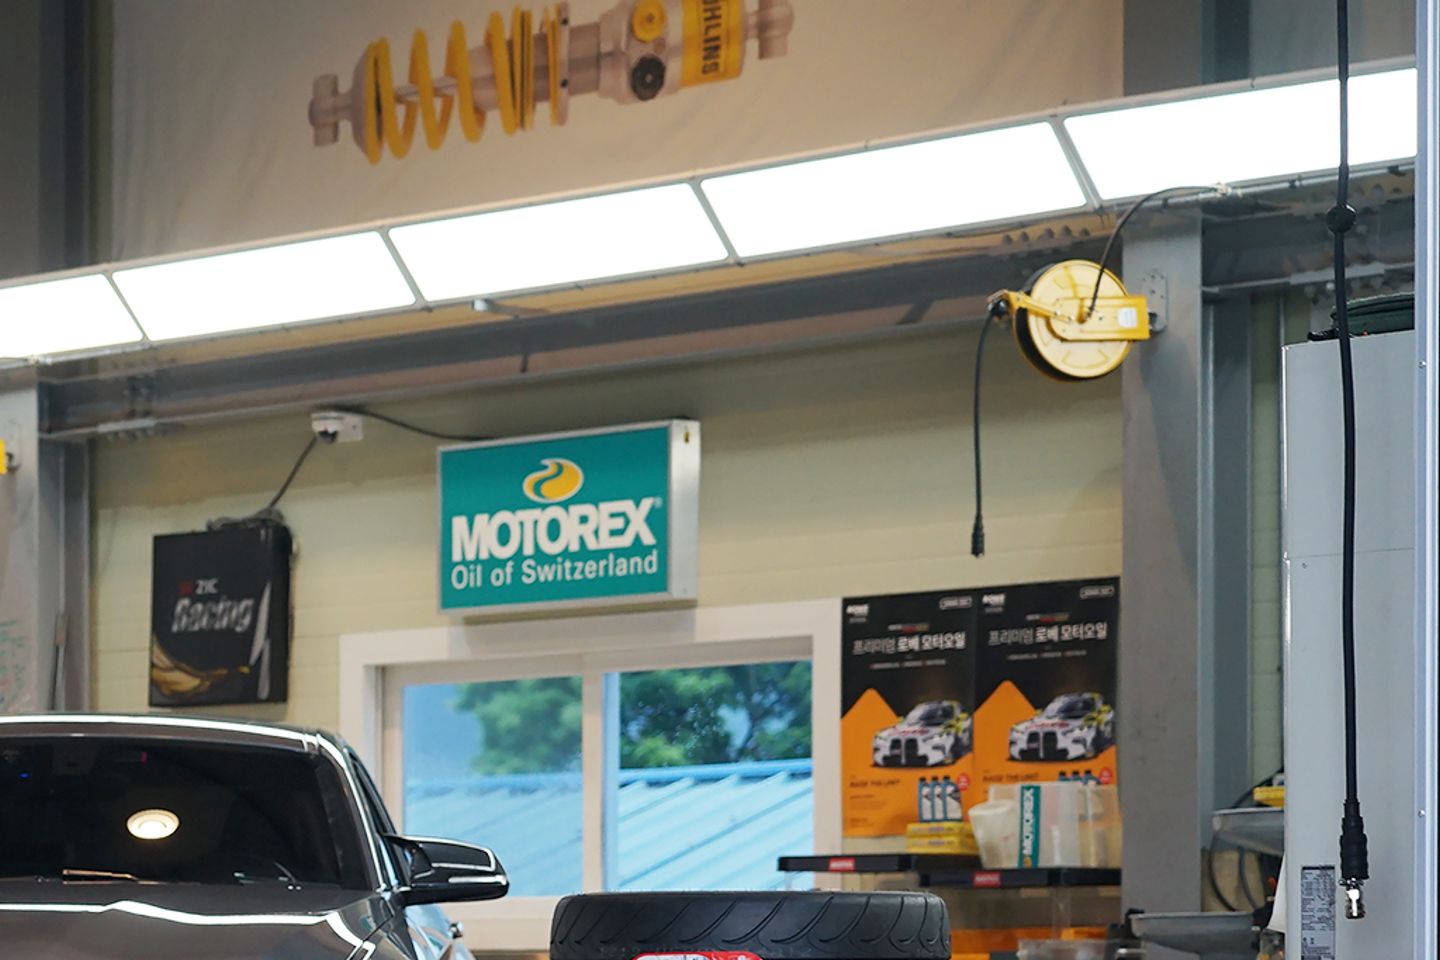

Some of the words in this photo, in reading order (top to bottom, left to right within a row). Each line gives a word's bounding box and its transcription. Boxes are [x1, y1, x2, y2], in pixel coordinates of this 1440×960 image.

[451, 497, 657, 562] MOTOREX
[451, 563, 482, 590] Oil
[490, 561, 514, 587] of
[521, 551, 658, 584] Switzerland
[852, 636, 895, 655] 프리미엄
[921, 631, 965, 650] 모터오일
[988, 628, 1033, 646] 프리미엄
[1061, 621, 1108, 640] 모터오일
[1022, 788, 1035, 855] MOTOREX
